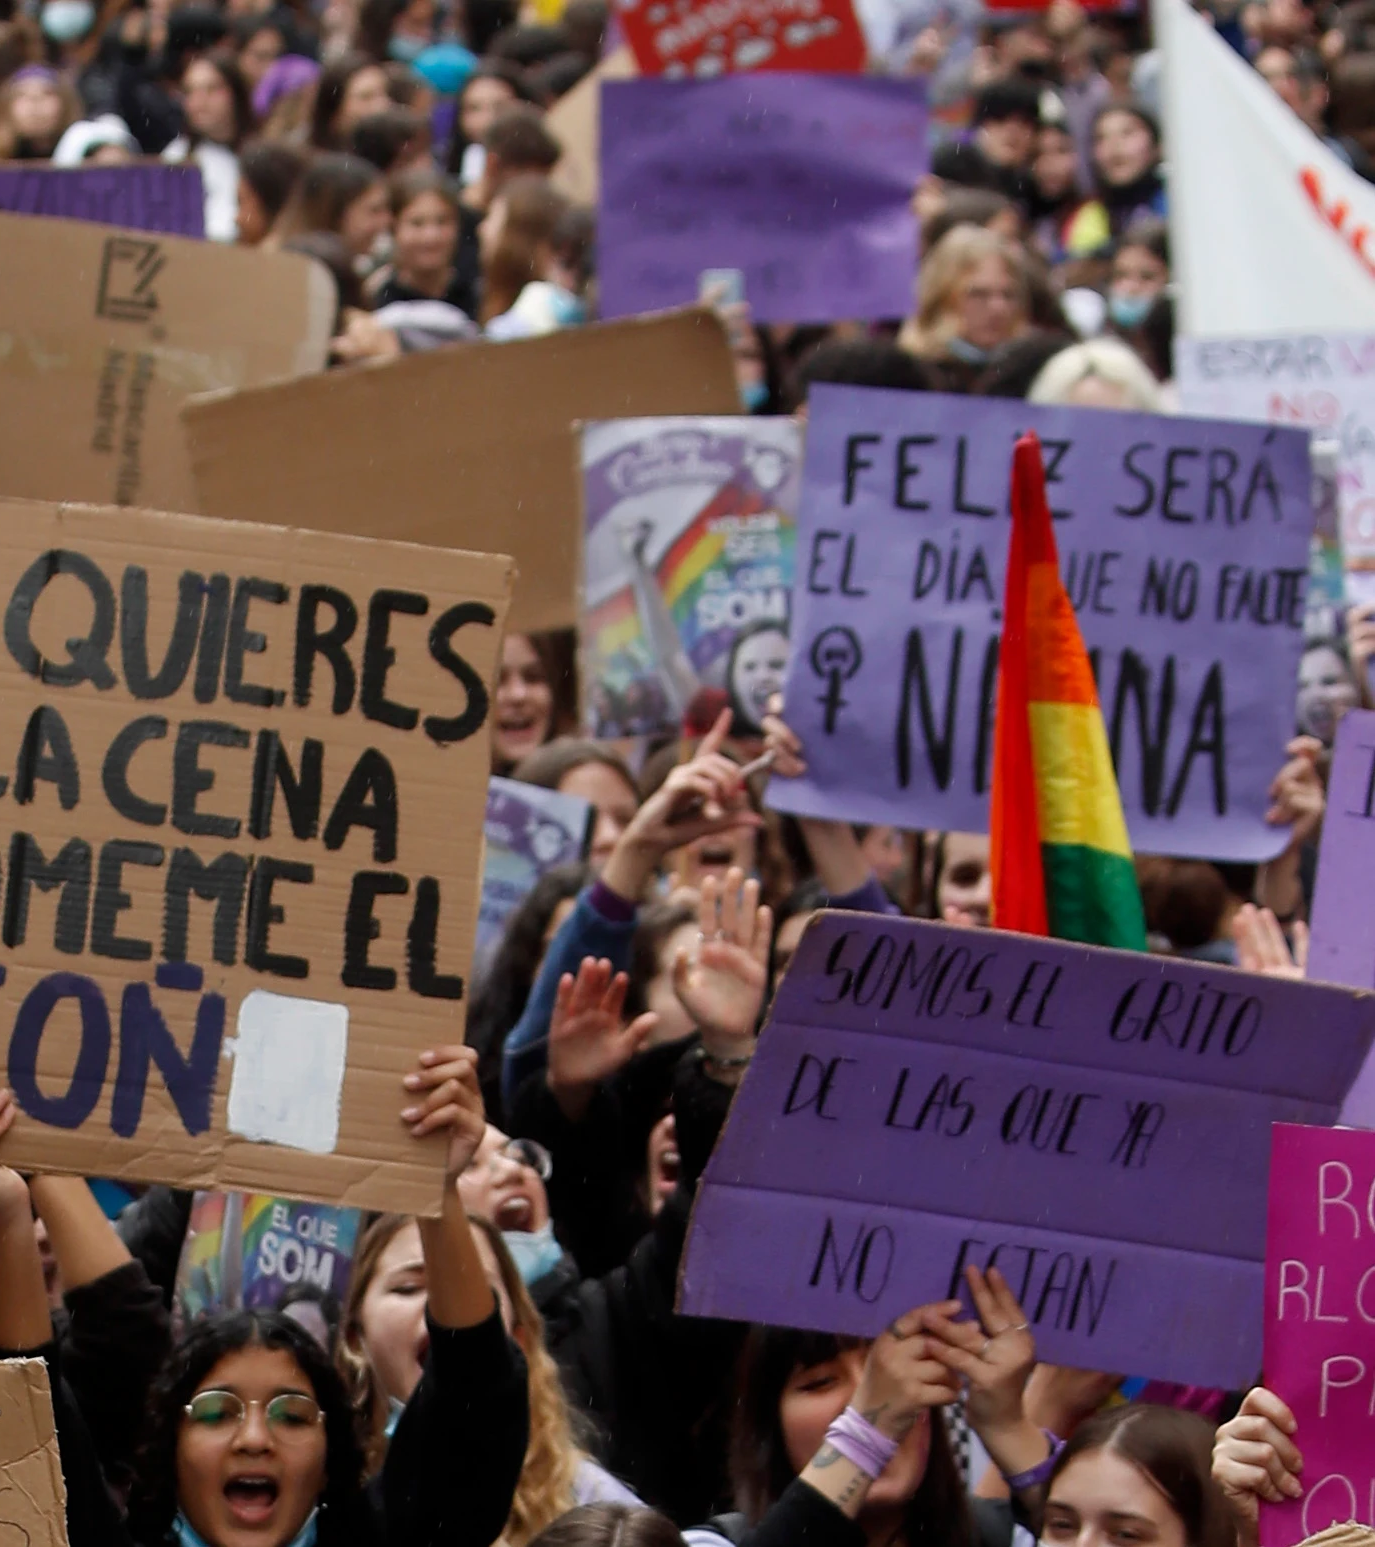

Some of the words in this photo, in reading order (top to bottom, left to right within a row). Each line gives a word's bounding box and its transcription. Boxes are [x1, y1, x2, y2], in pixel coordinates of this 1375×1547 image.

[1196, 336, 1333, 380] ESTAR
[842, 431, 1073, 520] FELZ
[1115, 429, 1282, 526] SERÁ
[808, 528, 868, 597] EL
[1068, 551, 1122, 616] UE
[1140, 556, 1201, 623] NO
[1216, 563, 1310, 630] FALTE
[4, 549, 495, 745] QUIERES
[895, 612, 1227, 818] NINA
[101, 715, 398, 863] CENA
[340, 871, 463, 1000] EL
[815, 930, 999, 1018] SOMOS
[1006, 960, 1063, 1030] EL
[1109, 976, 1264, 1058] GRITO
[783, 1052, 859, 1121] DE
[884, 1066, 975, 1138] LAS
[999, 1083, 1102, 1156] QUE
[1109, 1100, 1166, 1169] YA
[271, 1203, 293, 1233] EL
[296, 1215, 339, 1247] QUE
[1317, 1160, 1375, 1240] R
[257, 1231, 334, 1291] SOM
[808, 1217, 895, 1304] NO
[1320, 1355, 1375, 1418] P
